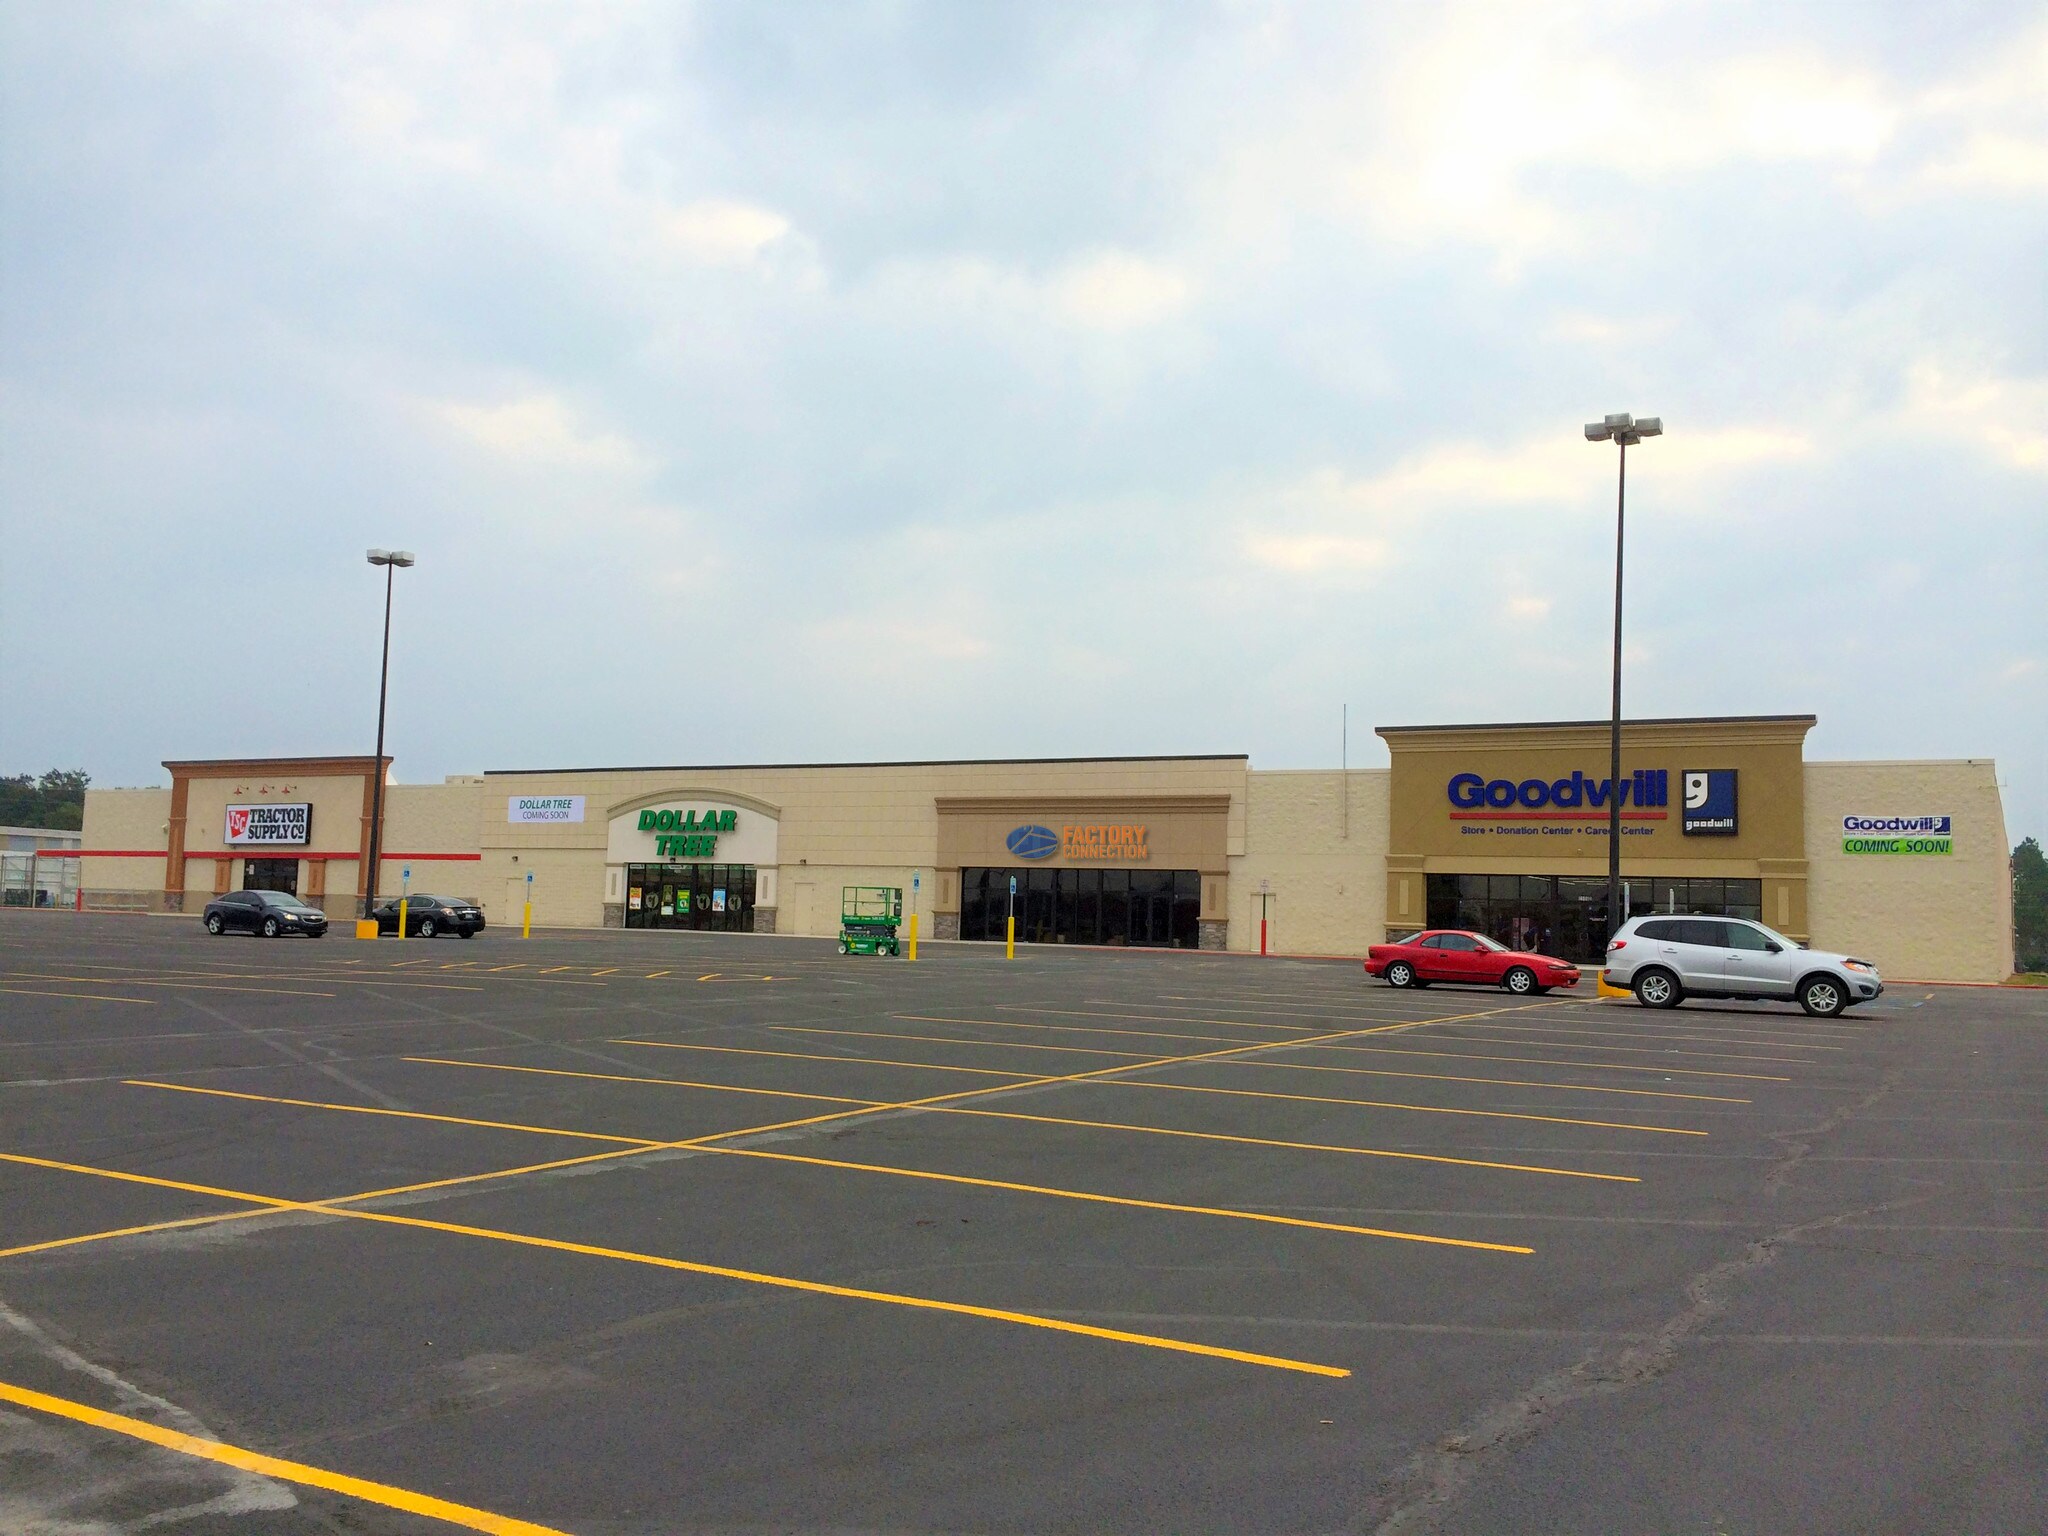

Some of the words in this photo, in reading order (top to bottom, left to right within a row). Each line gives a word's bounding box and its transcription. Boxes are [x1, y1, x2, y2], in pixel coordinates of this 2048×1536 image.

[1447, 769, 1668, 808] Goodwill
[519, 799, 552, 809] DOLLAR
[553, 799, 573, 809] TREE
[231, 811, 246, 833] TSC
[250, 808, 305, 823] TRACTOR
[522, 811, 549, 819] COMING
[550, 811, 569, 819] SOON
[637, 809, 737, 831] DOLLAR
[1461, 825, 1486, 835] Store
[1496, 825, 1539, 835] Donation
[1541, 826, 1574, 835] Center
[1584, 826, 1611, 835] Care
[1620, 826, 1655, 835] Center
[1686, 818, 1733, 831] goodwill
[1844, 816, 1933, 830] Goodwill
[248, 824, 290, 839] SUPPLY
[1063, 825, 1147, 844] FACTORY
[655, 834, 718, 857] TREE
[1063, 844, 1147, 859] CONNECTION
[1845, 840, 1900, 853] COMING
[1905, 840, 1949, 853] SOON!
